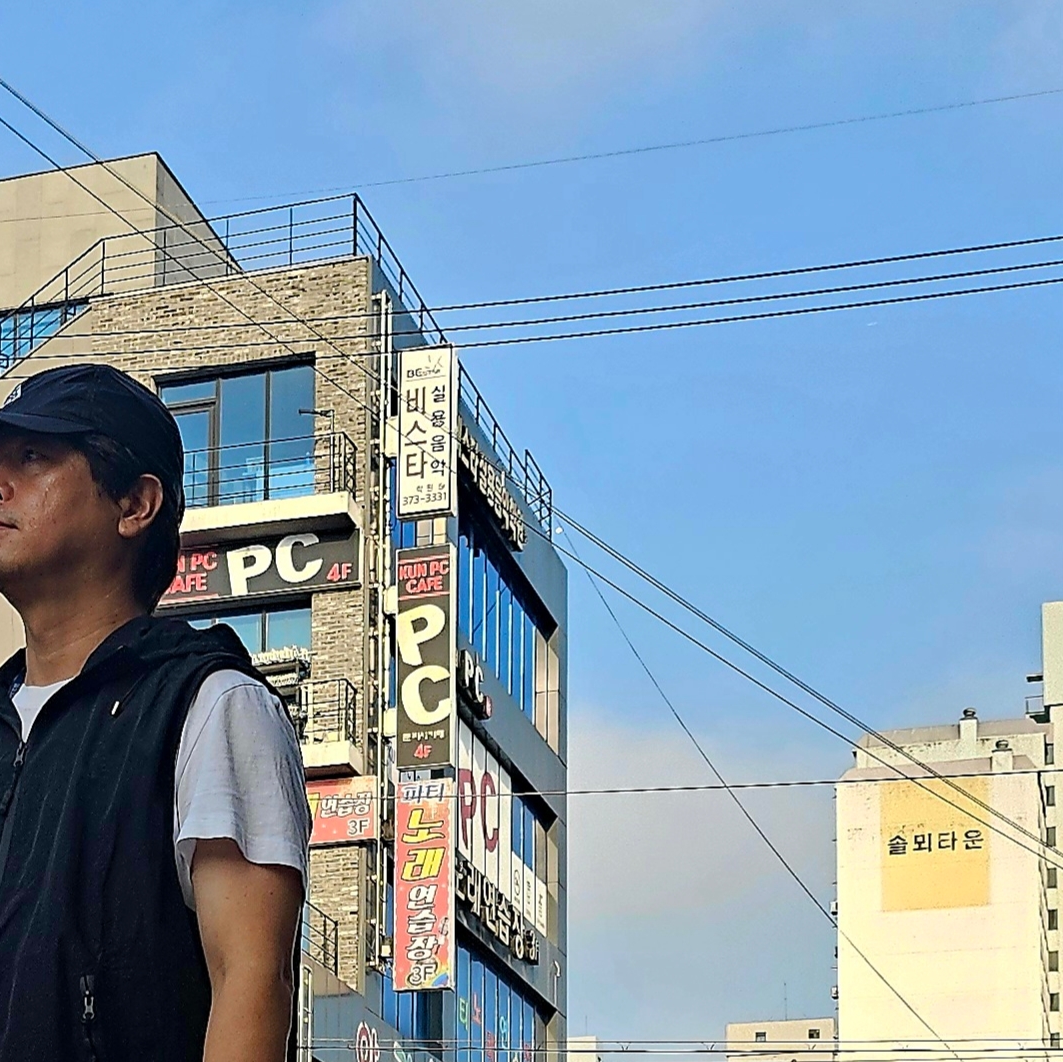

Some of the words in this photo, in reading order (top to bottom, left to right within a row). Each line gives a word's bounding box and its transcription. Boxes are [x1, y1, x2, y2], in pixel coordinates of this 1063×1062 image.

[404, 386, 427, 479] 비스타
[430, 385, 446, 477] 실용음악
[402, 491, 447, 506] 373-3331
[226, 533, 324, 596] PC
[326, 562, 353, 582] 4F
[429, 559, 451, 577] PC
[166, 572, 208, 594] AFE
[405, 575, 443, 594] CAFE
[397, 603, 451, 725] PC
[413, 743, 433, 759] 4F
[401, 782, 445, 804] 파티
[458, 768, 500, 853] PC
[347, 819, 370, 837] 3F
[887, 829, 985, 856] 솔뫼타운
[408, 964, 436, 985] 3F
